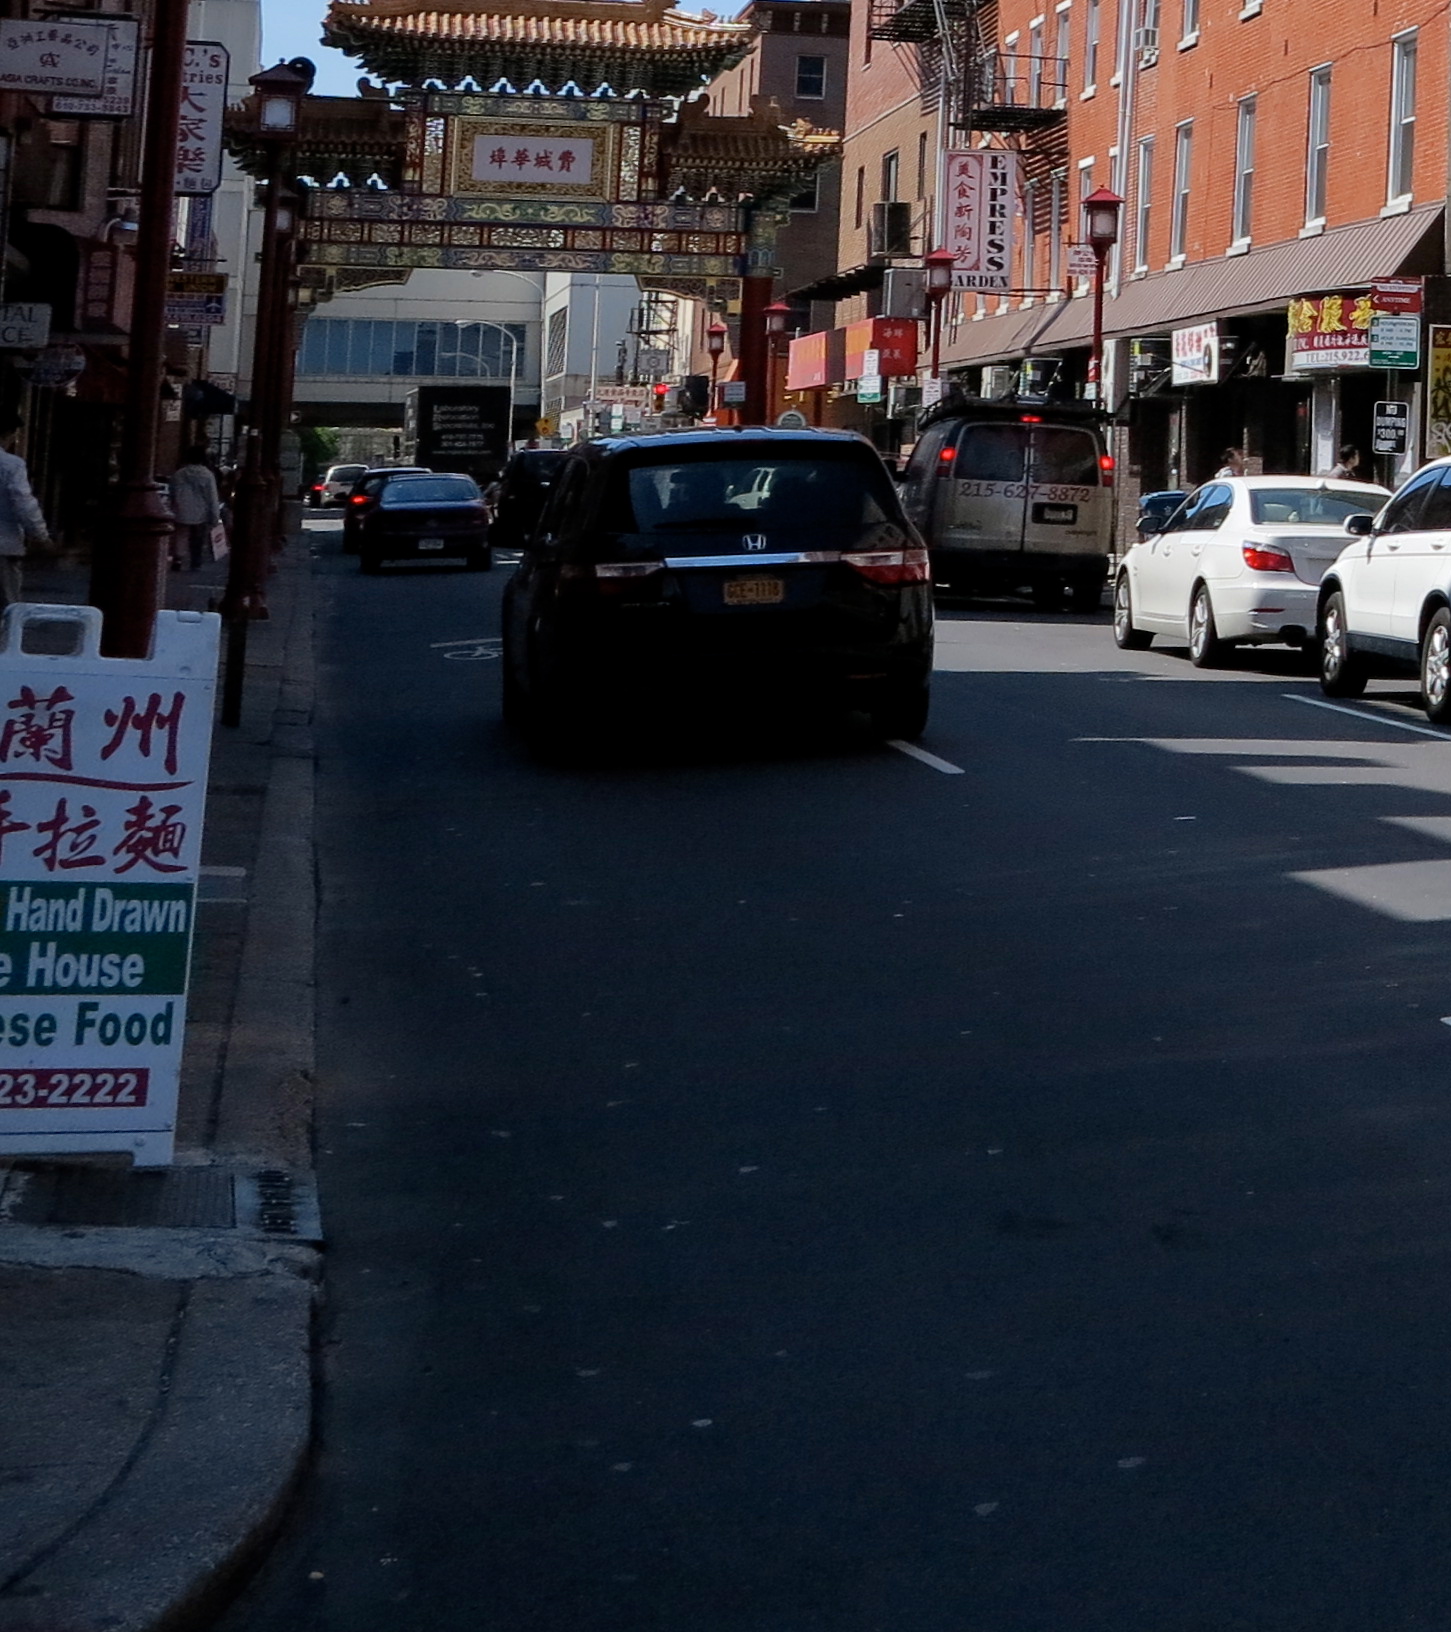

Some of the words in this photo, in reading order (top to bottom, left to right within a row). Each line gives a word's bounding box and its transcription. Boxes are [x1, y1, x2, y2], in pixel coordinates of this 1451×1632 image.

[24, 75, 64, 86] CRAFTS
[986, 155, 1008, 272] EMPRESS
[953, 275, 1009, 288] ARDEN
[1386, 404, 1398, 415] NO
[1376, 416, 1406, 427] DUMPING
[959, 481, 1091, 503] 215-627-8872
[6, 887, 83, 934] Hand
[92, 892, 187, 934] Drawn
[26, 941, 145, 989] House
[75, 1001, 174, 1047] Food
